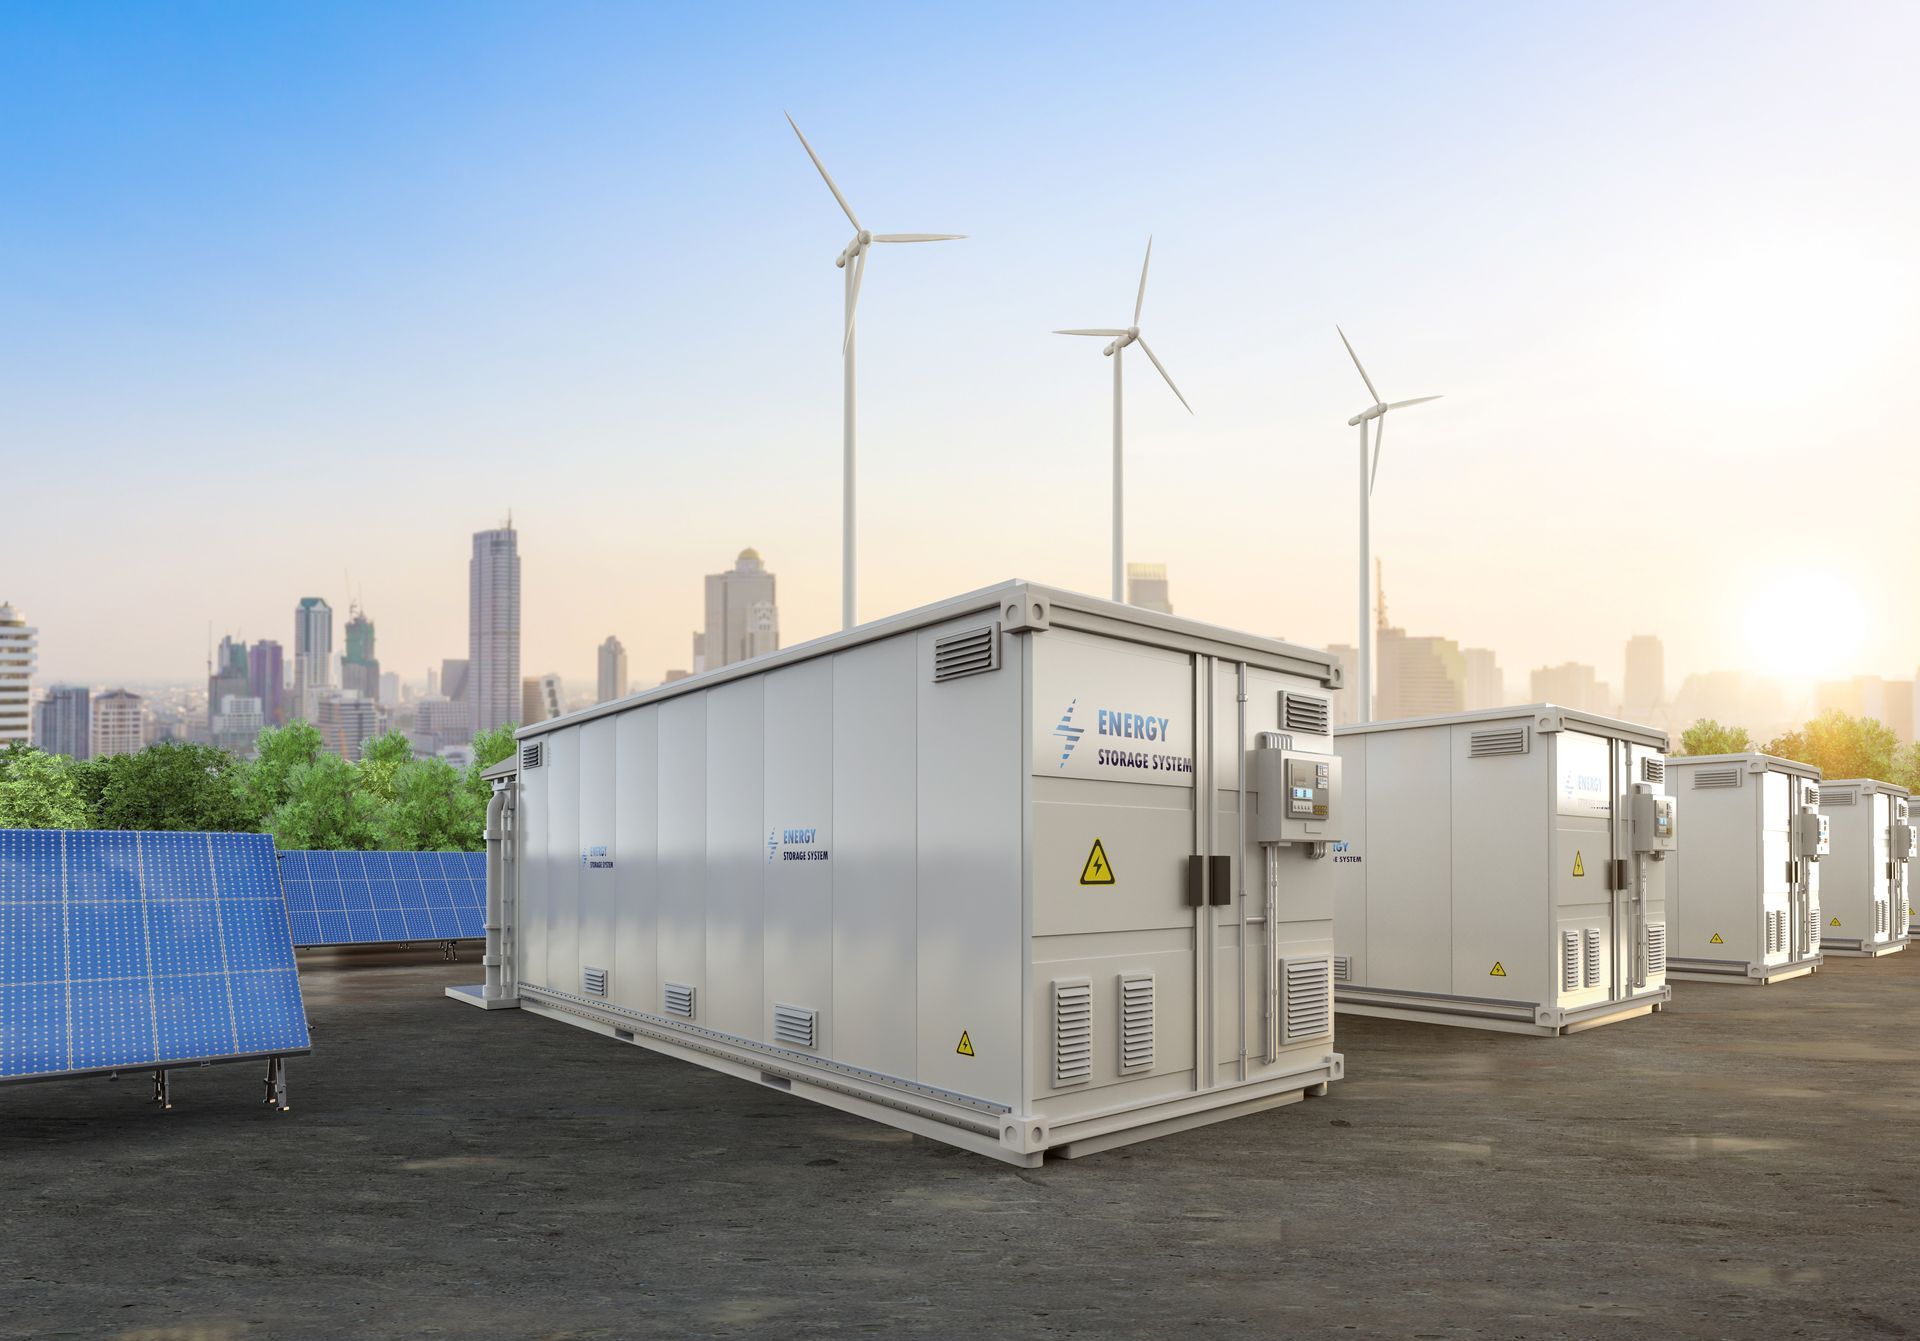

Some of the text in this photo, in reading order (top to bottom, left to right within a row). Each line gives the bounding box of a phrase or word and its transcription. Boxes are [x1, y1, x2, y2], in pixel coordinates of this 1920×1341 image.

[1098, 709, 1169, 742] ENERGY
[1098, 749, 1193, 773] STORAGE SYSTEM
[783, 828, 816, 844] ENERGY
[783, 850, 829, 861] STORAGE SYSTEM
